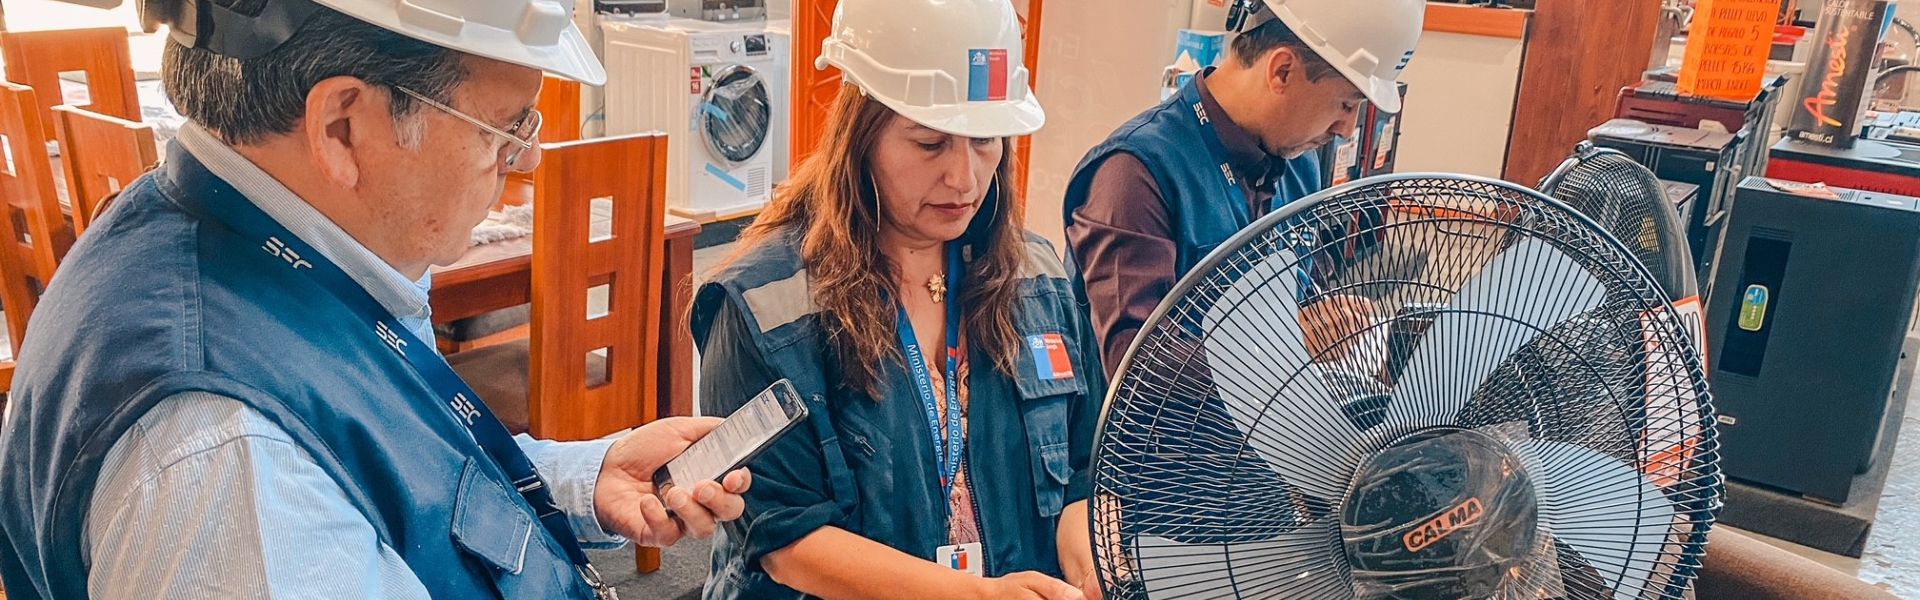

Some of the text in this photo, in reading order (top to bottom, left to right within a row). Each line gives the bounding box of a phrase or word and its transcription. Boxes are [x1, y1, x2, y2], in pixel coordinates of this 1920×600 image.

[1825, 7, 1875, 20] SUSTENTABLE
[1751, 25, 1760, 41] 5
[1699, 59, 1727, 73] PELLET
[1804, 25, 1849, 127] Amesti
[1193, 102, 1209, 125] SEC
[1799, 131, 1834, 144] amesti.cl
[1220, 162, 1236, 186] SEC
[262, 236, 313, 269] SEC
[375, 320, 408, 356] SEC
[907, 344, 931, 400] Ministerio
[927, 402, 935, 417] de
[450, 392, 481, 426] SEC
[949, 412, 959, 427] de
[948, 431, 960, 487] Ministerio
[1408, 500, 1482, 548] CALMA
